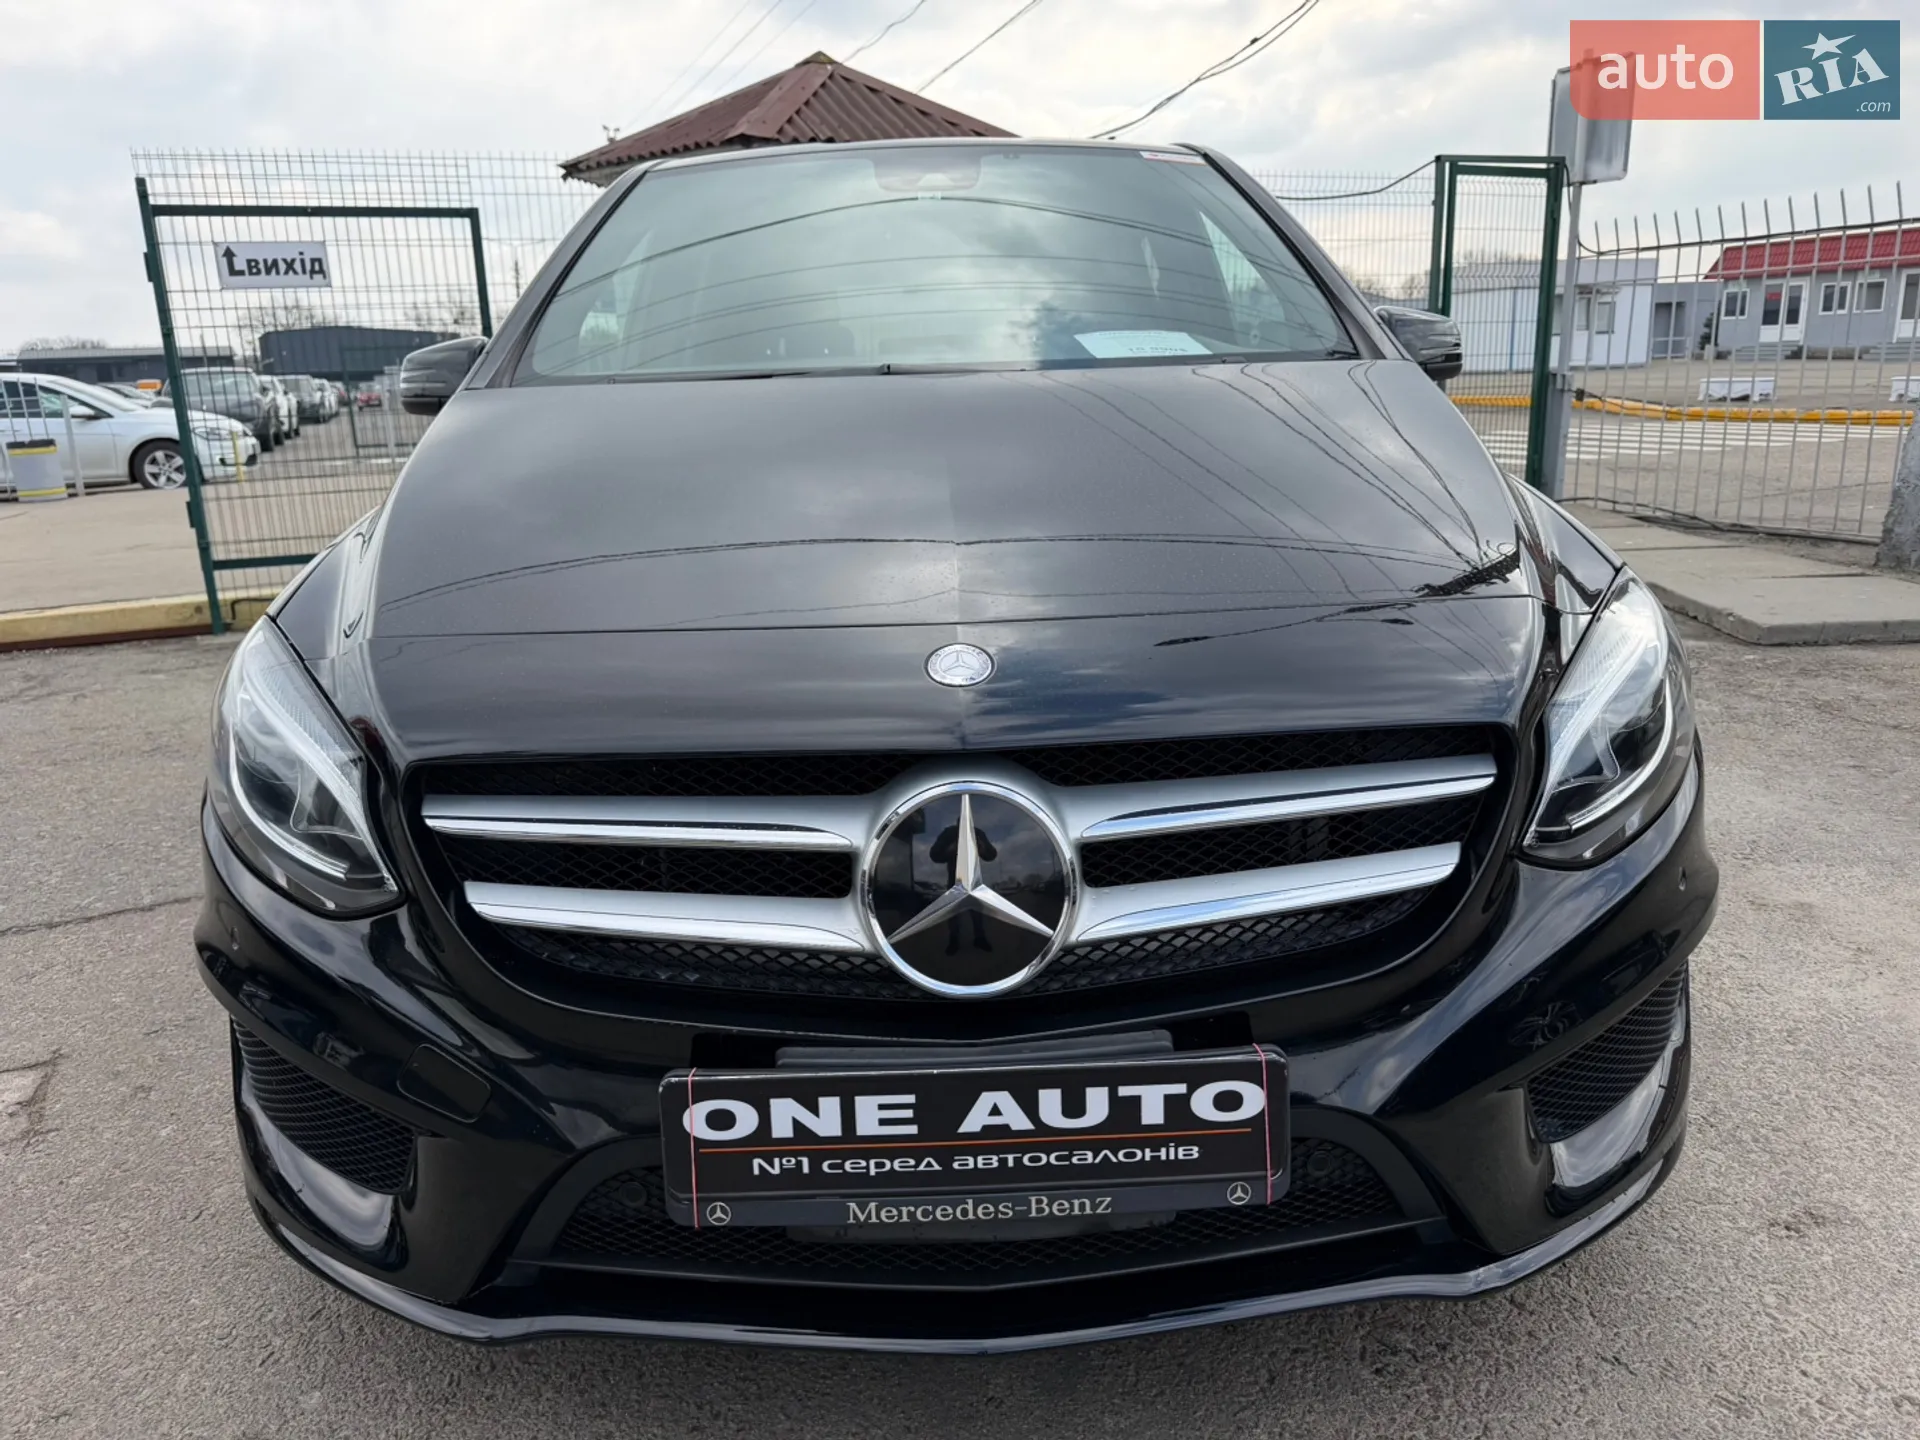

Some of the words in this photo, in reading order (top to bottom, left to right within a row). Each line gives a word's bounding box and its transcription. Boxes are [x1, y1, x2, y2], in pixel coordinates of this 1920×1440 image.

[246, 251, 327, 280] вихід
[682, 1094, 918, 1141] ONE
[956, 1080, 1266, 1133] AUTO
[821, 1157, 943, 1176] серед
[951, 1143, 1200, 1170] автосалонів
[846, 1196, 1113, 1224] Mercedes-Benz
